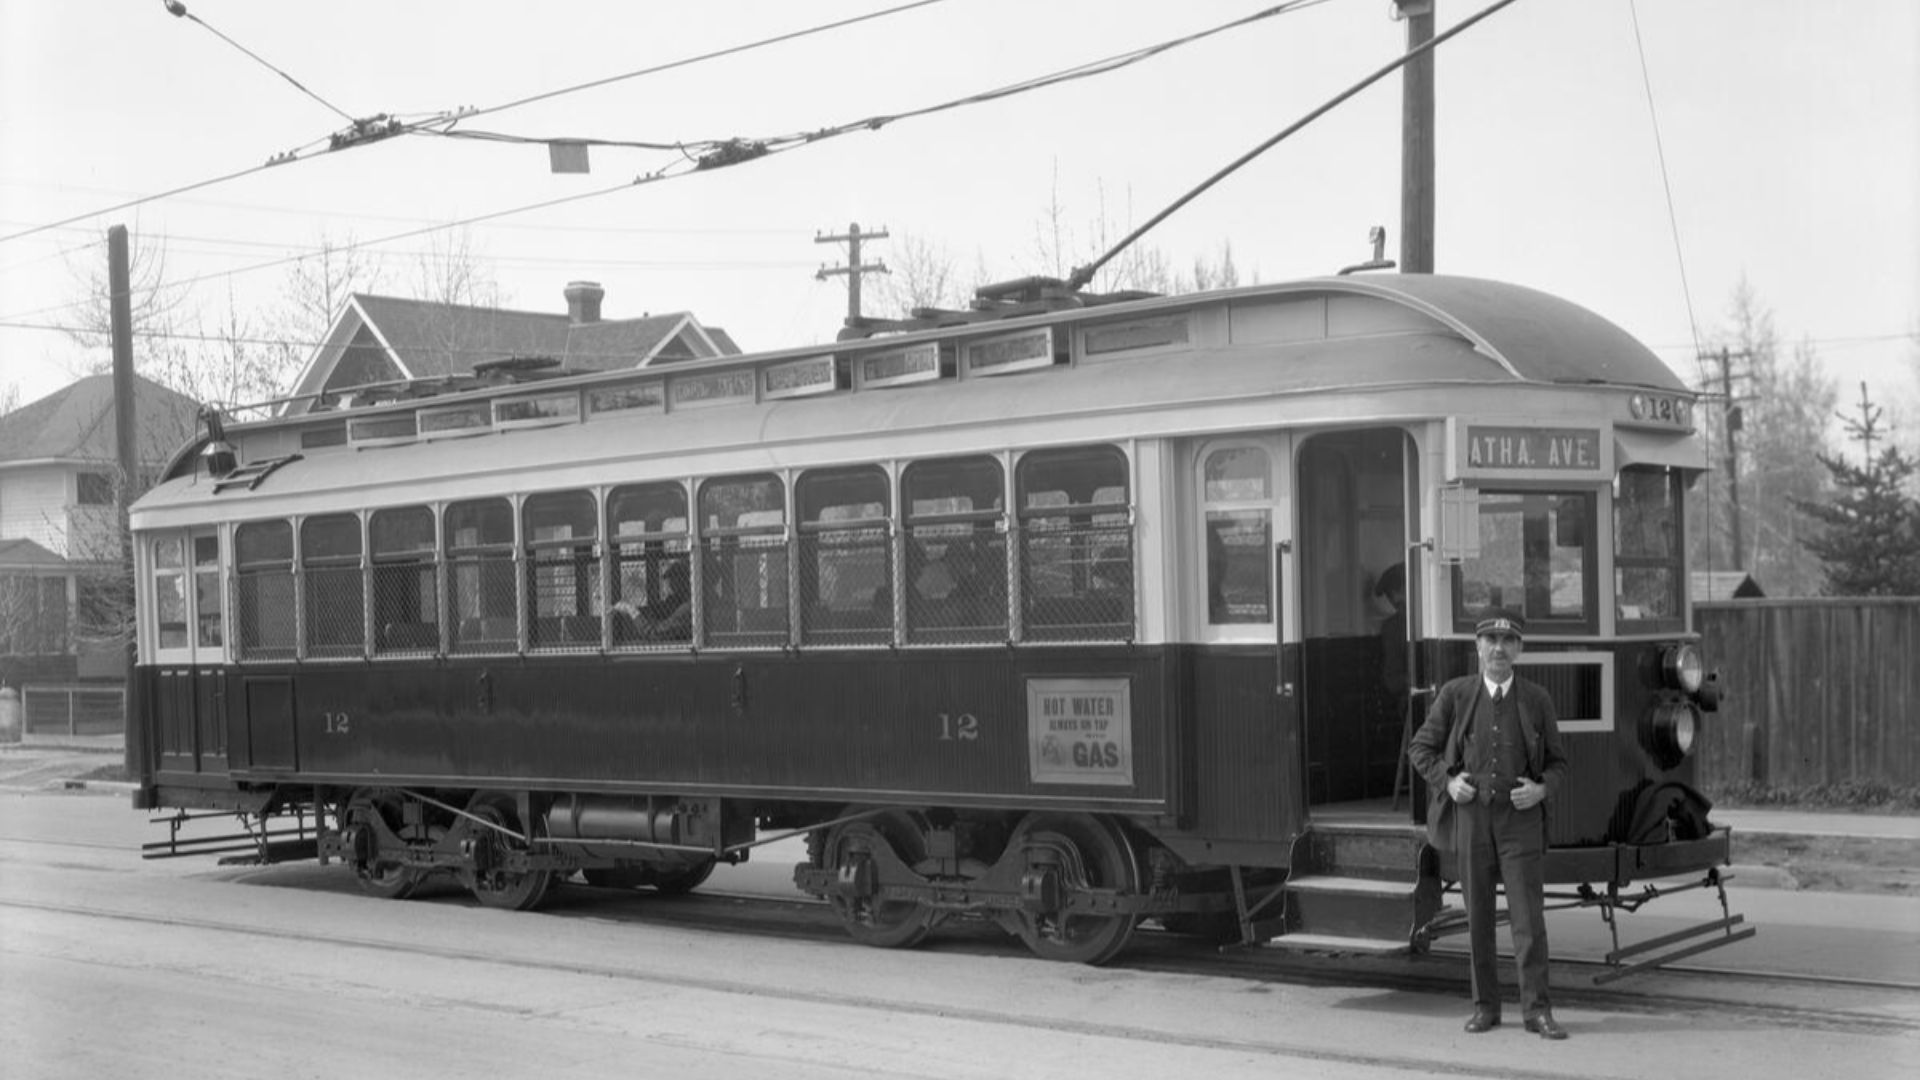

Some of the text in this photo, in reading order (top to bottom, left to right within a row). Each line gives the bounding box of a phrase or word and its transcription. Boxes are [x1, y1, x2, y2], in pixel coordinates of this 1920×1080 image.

[1649, 398, 1671, 421] 12
[1470, 436, 1595, 467] ATHA. AVE.
[1043, 697, 1114, 717] HOT WATER
[325, 711, 349, 734] 12
[939, 713, 978, 740] 12
[1072, 741, 1119, 768] GAS
